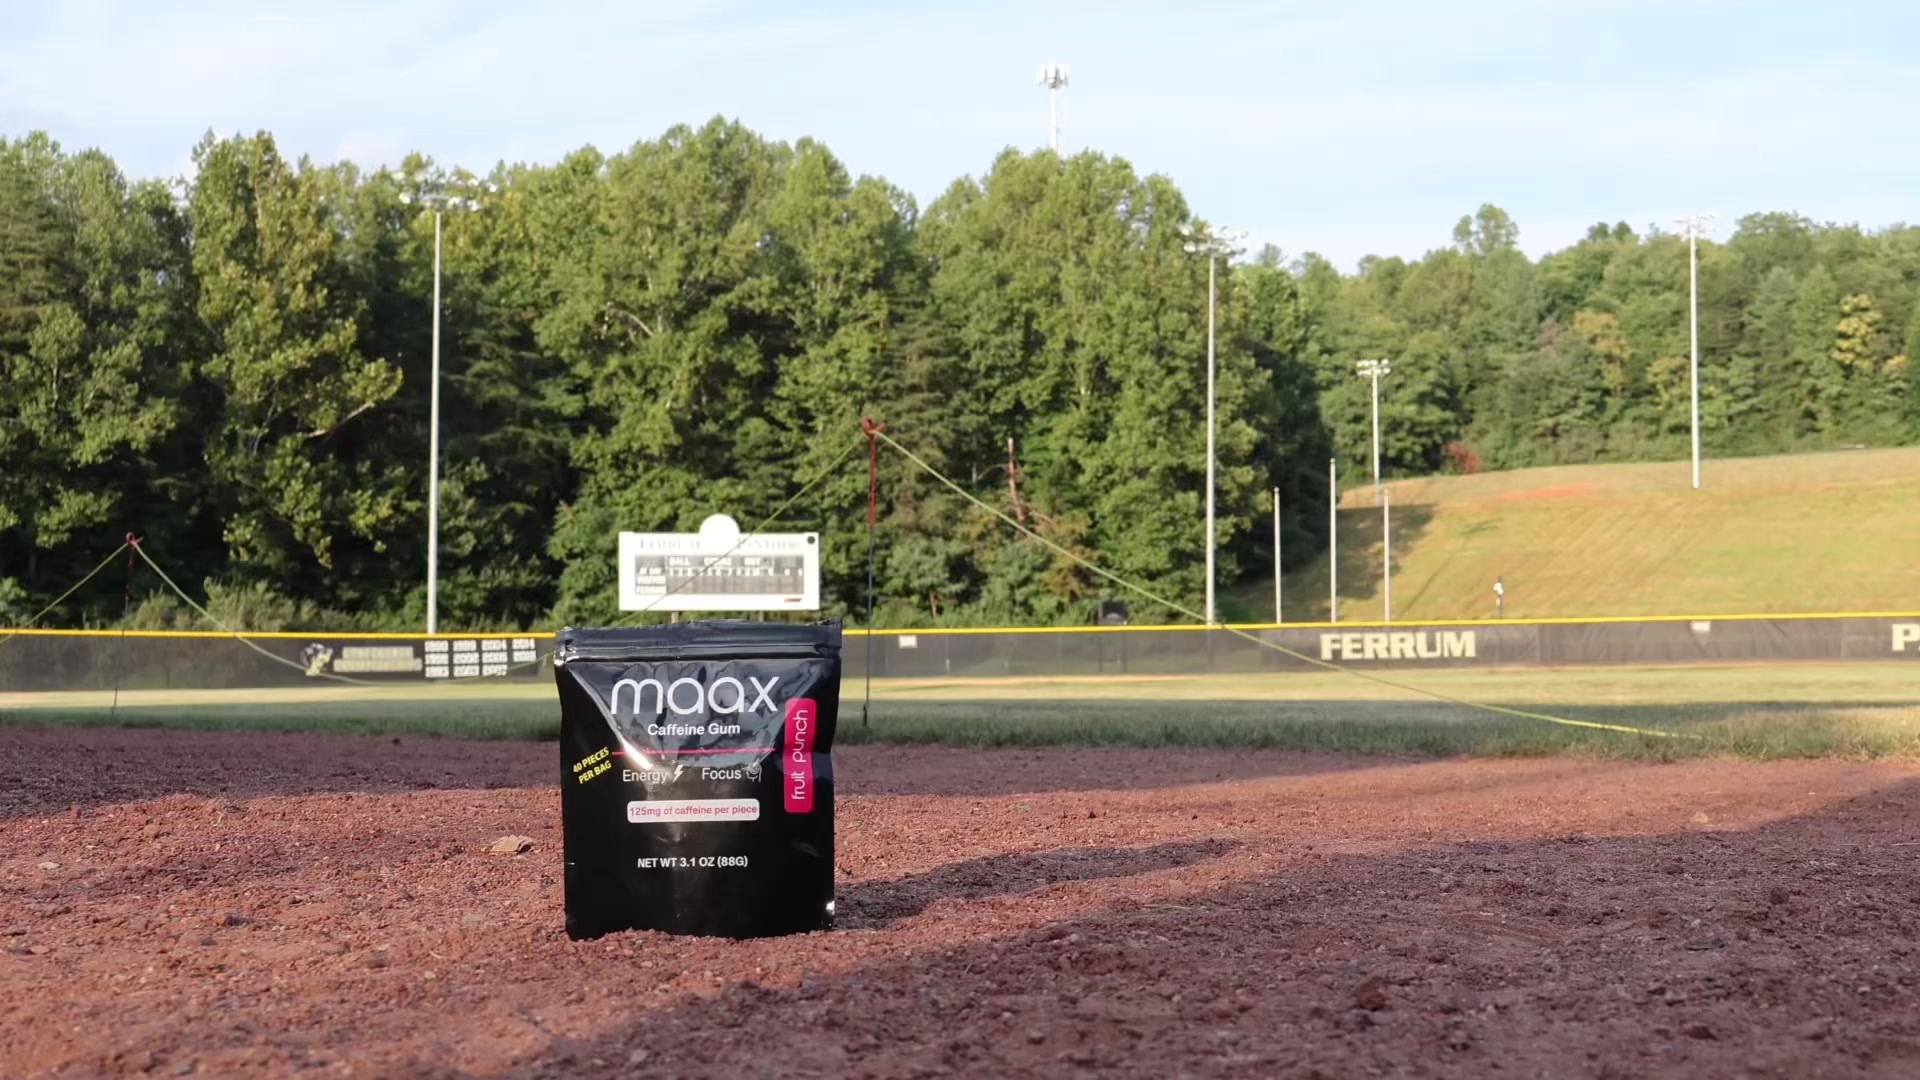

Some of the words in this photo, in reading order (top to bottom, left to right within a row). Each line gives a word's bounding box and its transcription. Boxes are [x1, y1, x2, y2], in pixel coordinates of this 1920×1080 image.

[1320, 631, 1476, 660] FERRUM
[1892, 624, 1920, 652] P
[611, 676, 779, 715] maax
[648, 724, 705, 736] Caffeine
[708, 723, 741, 735] Gum
[792, 710, 808, 763] punch
[573, 762, 583, 773] 40
[582, 746, 609, 768] PIECES
[578, 769, 595, 785] PER
[594, 760, 612, 776] BAG
[622, 769, 668, 784] Energy
[702, 767, 742, 780] Focus
[791, 770, 806, 800] fruit
[630, 806, 661, 817] 125mg
[664, 806, 673, 815] of
[675, 805, 712, 815] caffeine
[714, 806, 730, 816] per
[732, 804, 758, 815] piece
[637, 858, 659, 868] NET
[660, 858, 678, 868] WT
[680, 857, 696, 867] 3.1
[699, 856, 715, 867] OZ
[717, 855, 748, 868] (88G)
